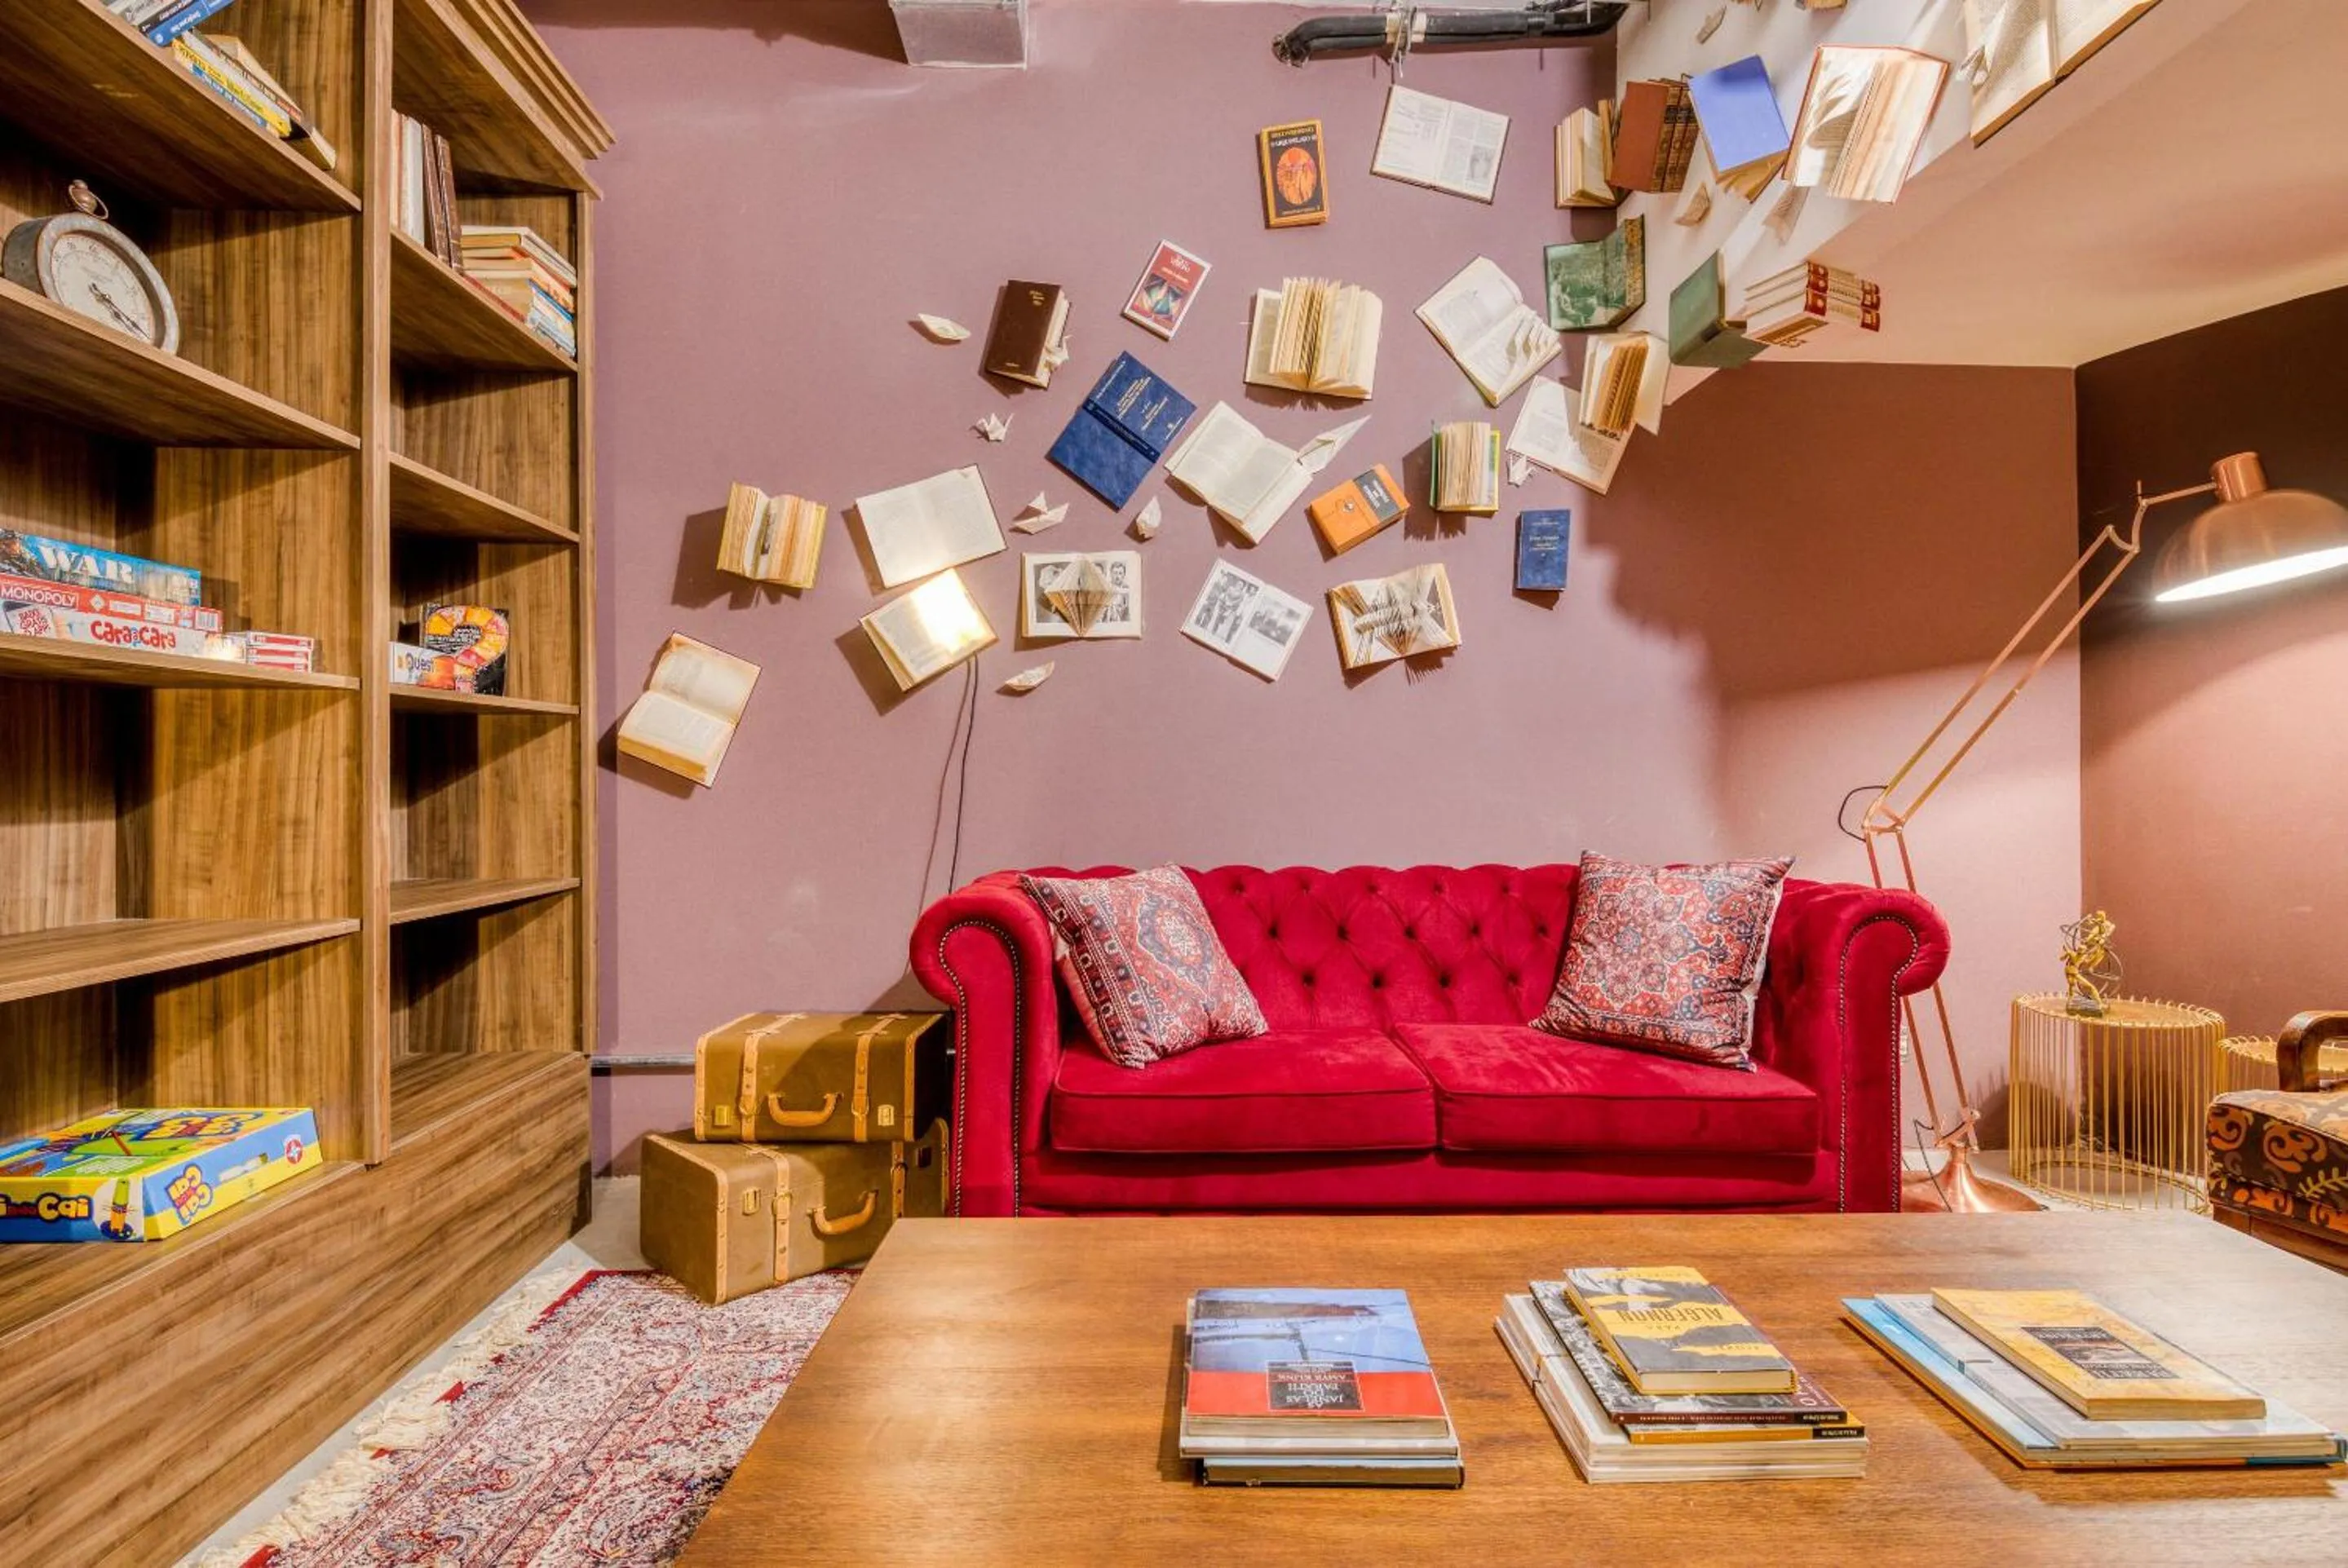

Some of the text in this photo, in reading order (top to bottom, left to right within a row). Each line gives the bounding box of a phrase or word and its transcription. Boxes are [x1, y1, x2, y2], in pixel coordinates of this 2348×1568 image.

[38, 545, 134, 583] WAR
[1, 585, 76, 607] MONOPOLY
[38, 1195, 89, 1221] Cai
[1616, 1305, 1725, 1323] ALGERNON
